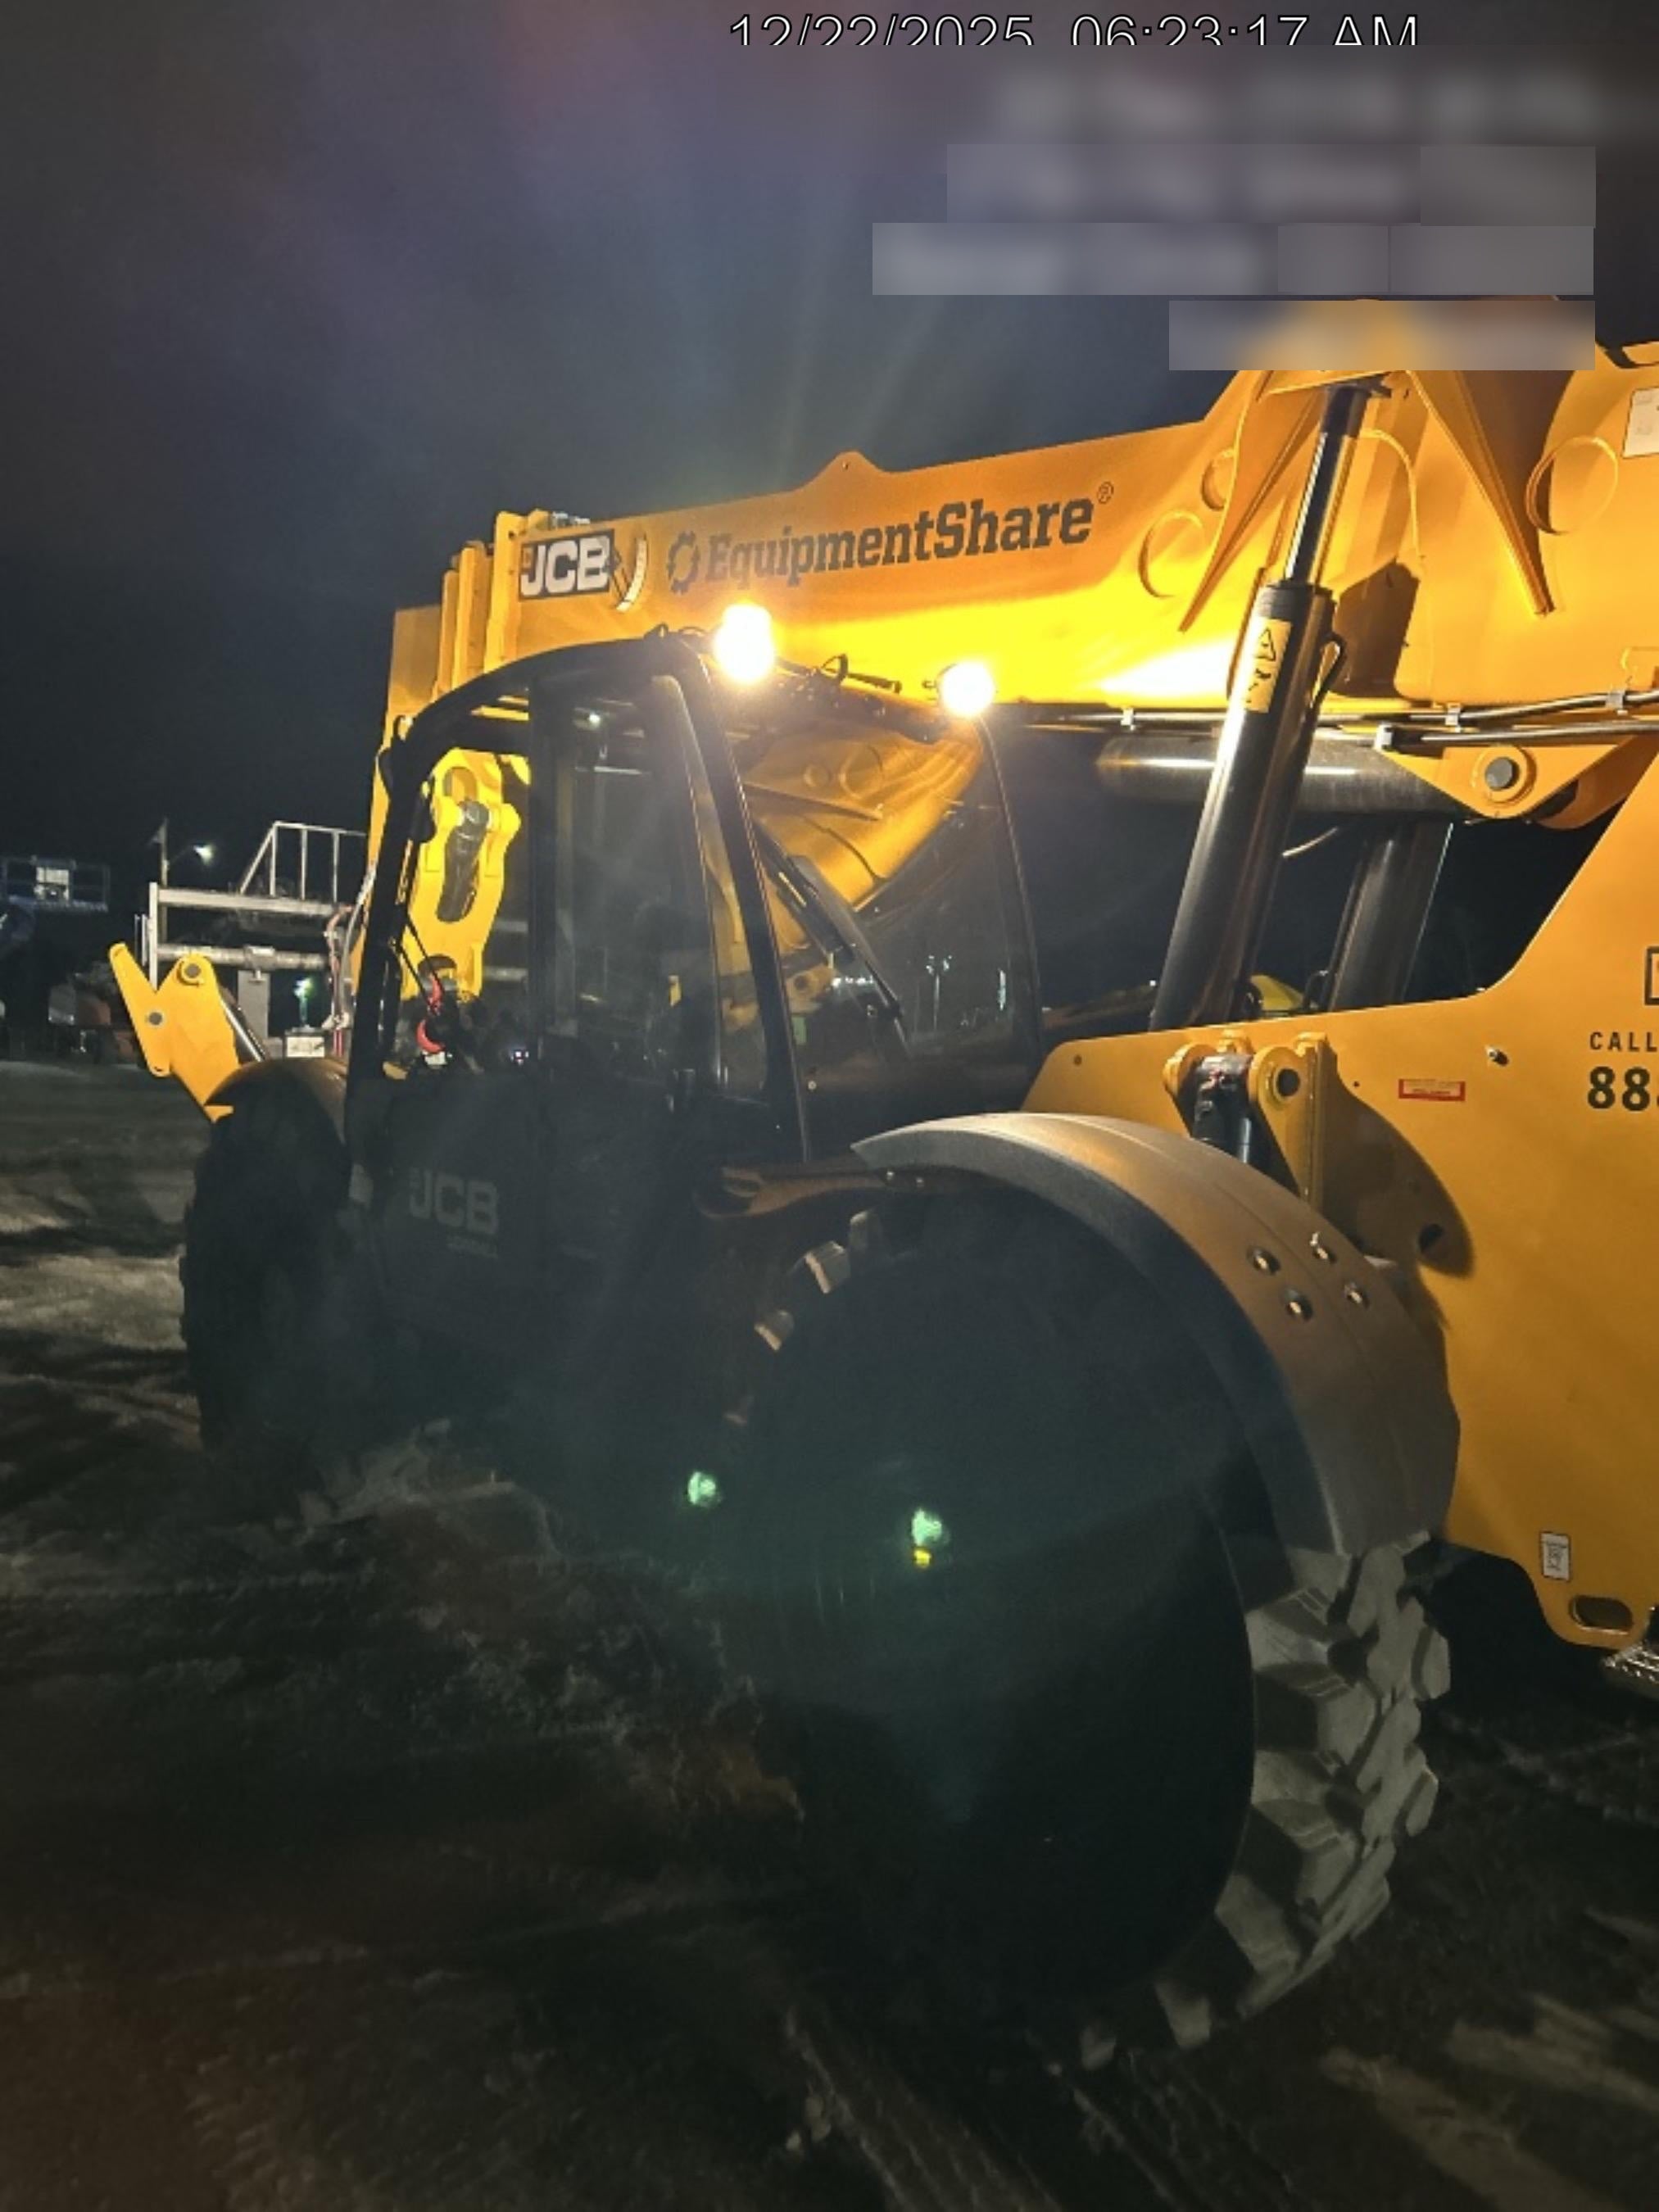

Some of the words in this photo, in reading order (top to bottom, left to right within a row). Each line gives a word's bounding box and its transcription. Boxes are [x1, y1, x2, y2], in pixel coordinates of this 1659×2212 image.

[519, 535, 611, 596] JCB
[1589, 1031, 1658, 1053] CALL
[1587, 1066, 1659, 1112] 88
[410, 1167, 500, 1235] JCB
